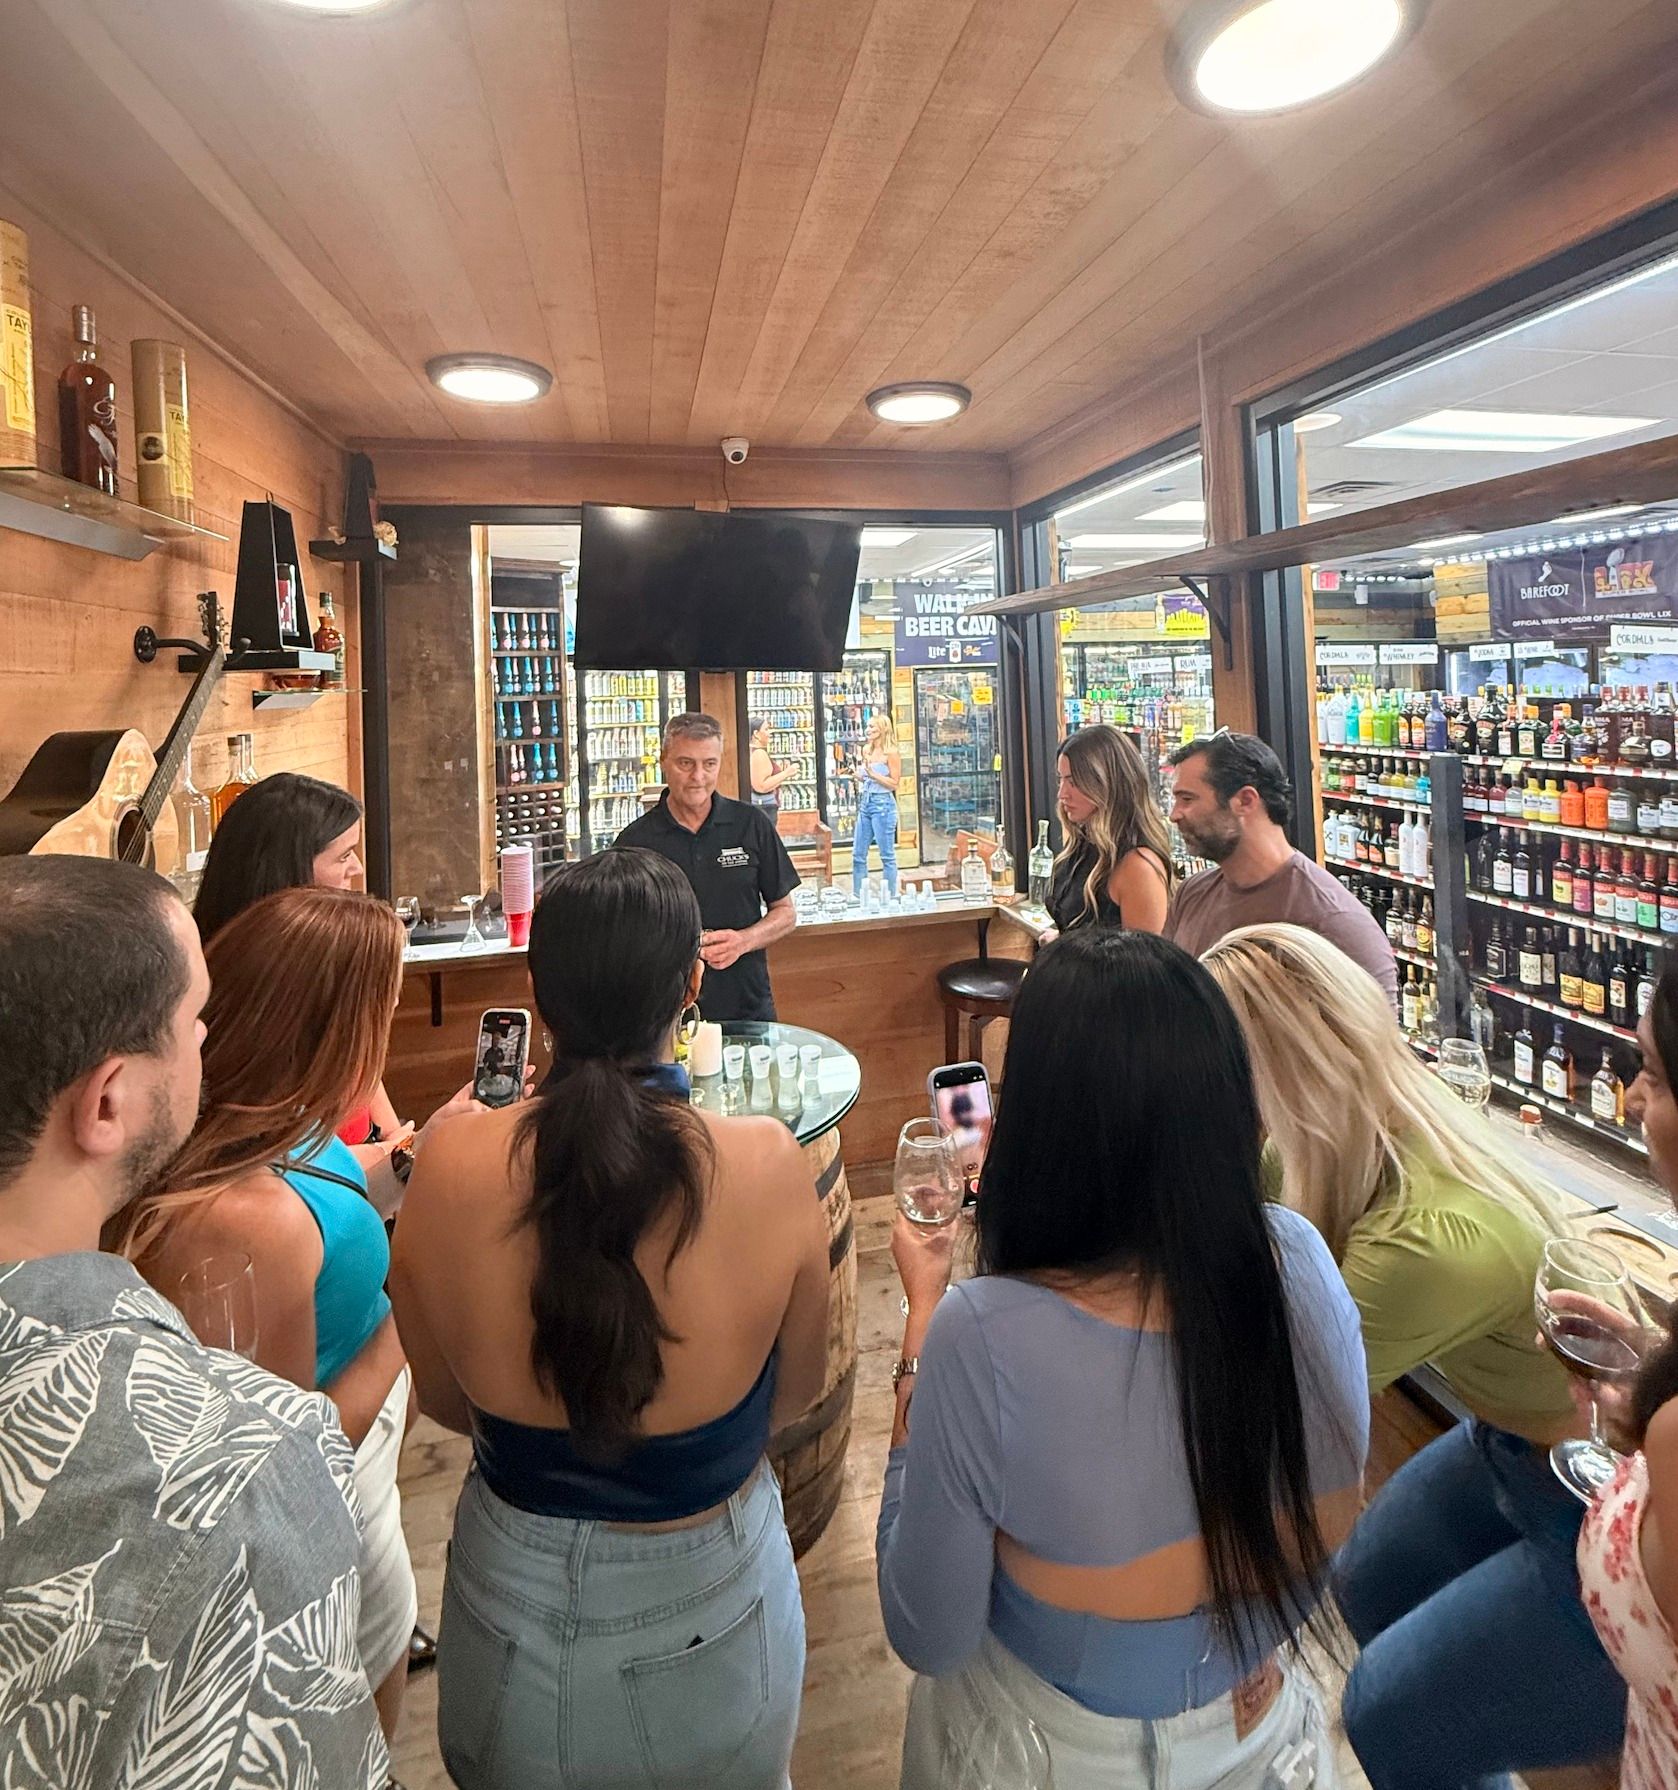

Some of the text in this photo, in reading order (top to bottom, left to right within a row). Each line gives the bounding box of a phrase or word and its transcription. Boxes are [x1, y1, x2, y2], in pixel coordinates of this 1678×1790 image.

[1520, 583, 1570, 600] BAREFOOT
[905, 615, 955, 637] BEER
[1512, 619, 1541, 628] OFFICIAL
[1541, 617, 1560, 625] WINE
[1561, 615, 1592, 624] SPONSOR
[1593, 614, 1605, 622] OF
[1632, 610, 1656, 620] BOWL
[928, 646, 947, 659] Lite
